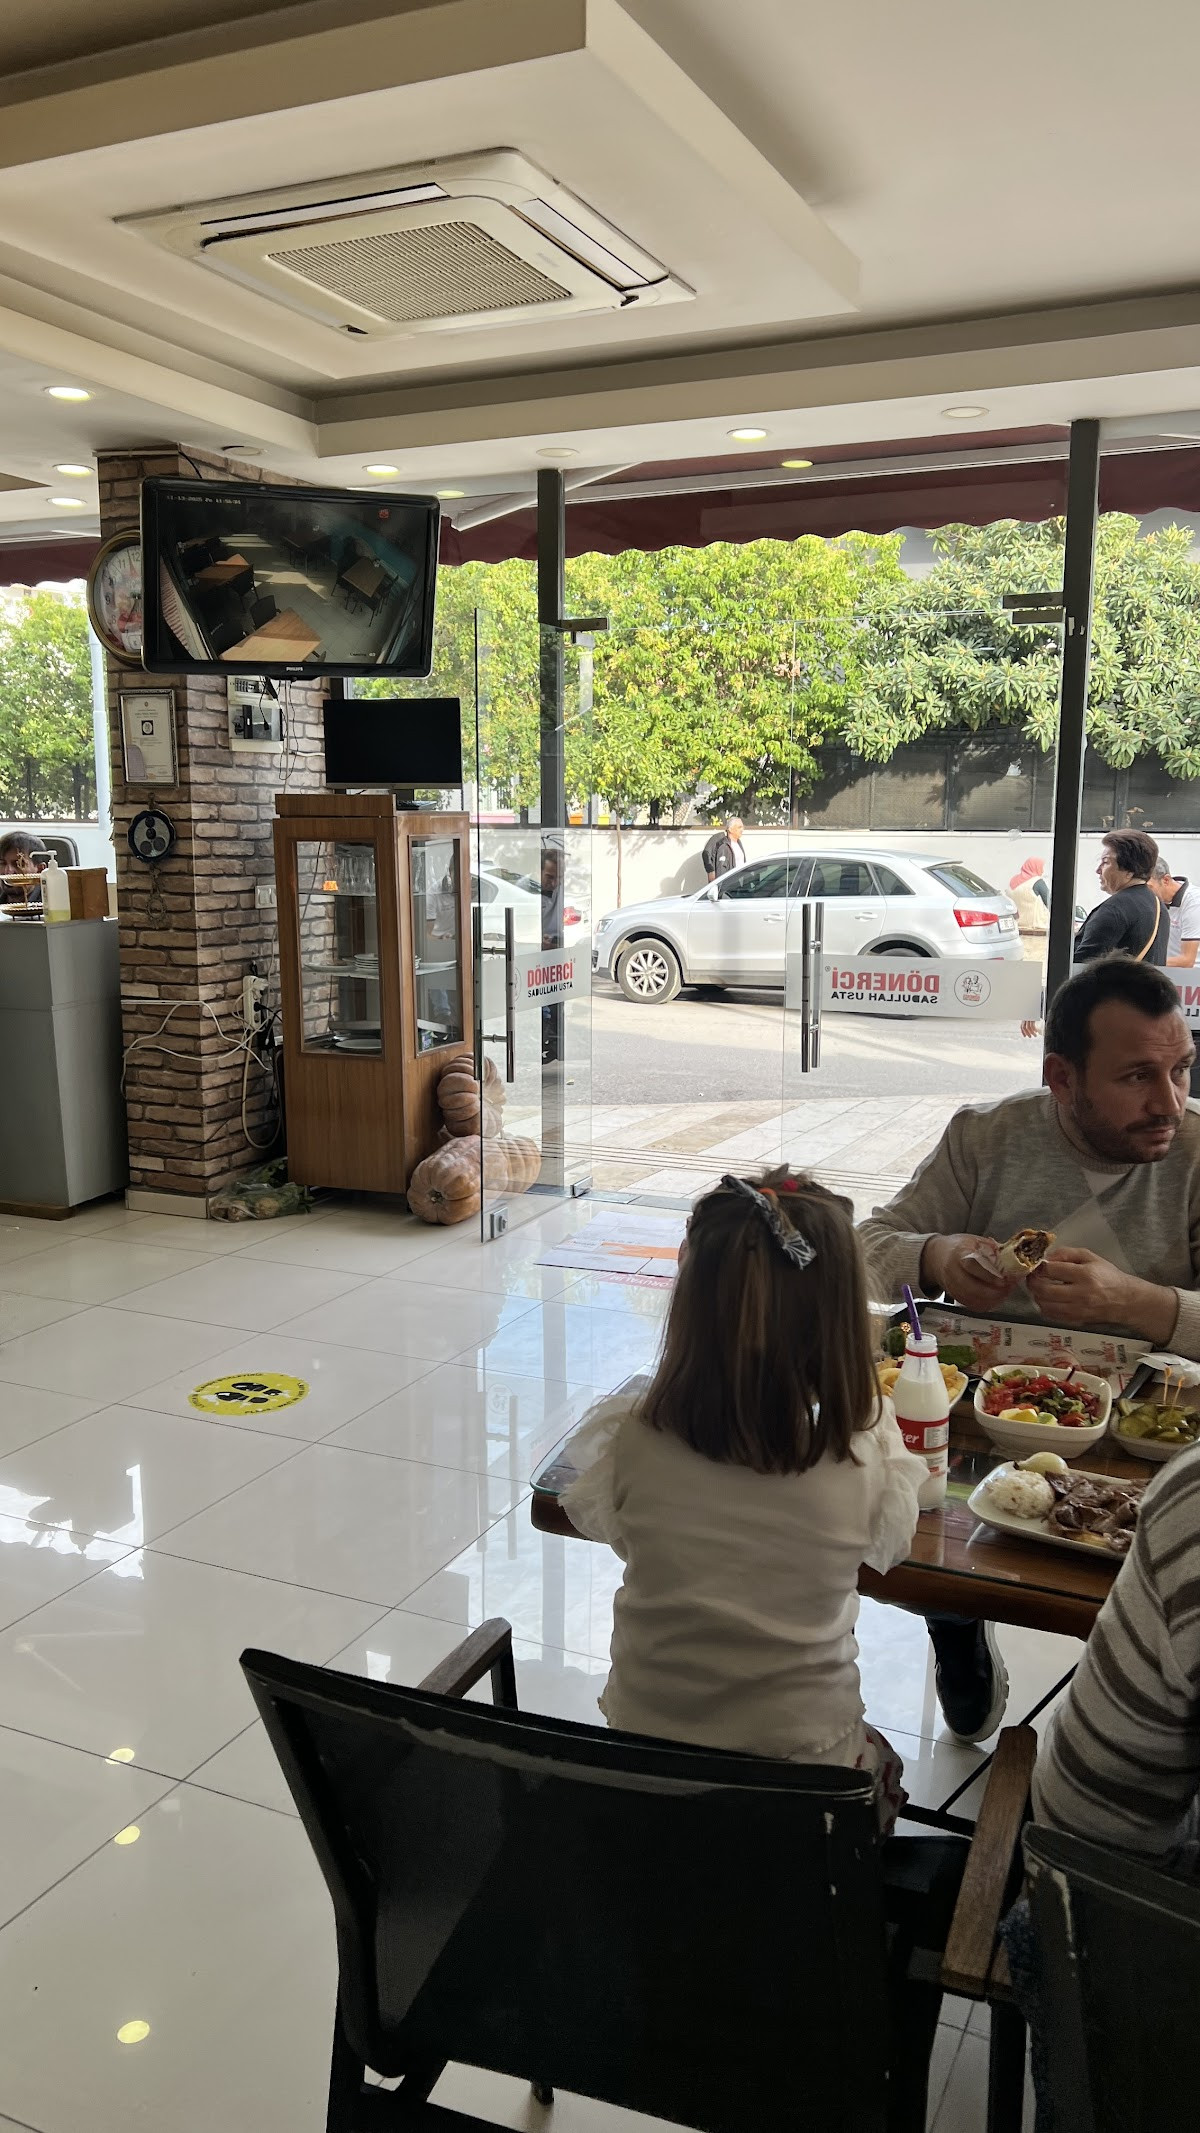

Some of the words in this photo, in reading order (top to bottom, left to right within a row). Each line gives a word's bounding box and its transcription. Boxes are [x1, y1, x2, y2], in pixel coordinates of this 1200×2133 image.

[131, 552, 141, 562] 12
[118, 559, 127, 569] 11
[527, 959, 574, 988] DÖNERCİ
[527, 984, 558, 998] SADULLAH
[558, 981, 574, 991] USTA
